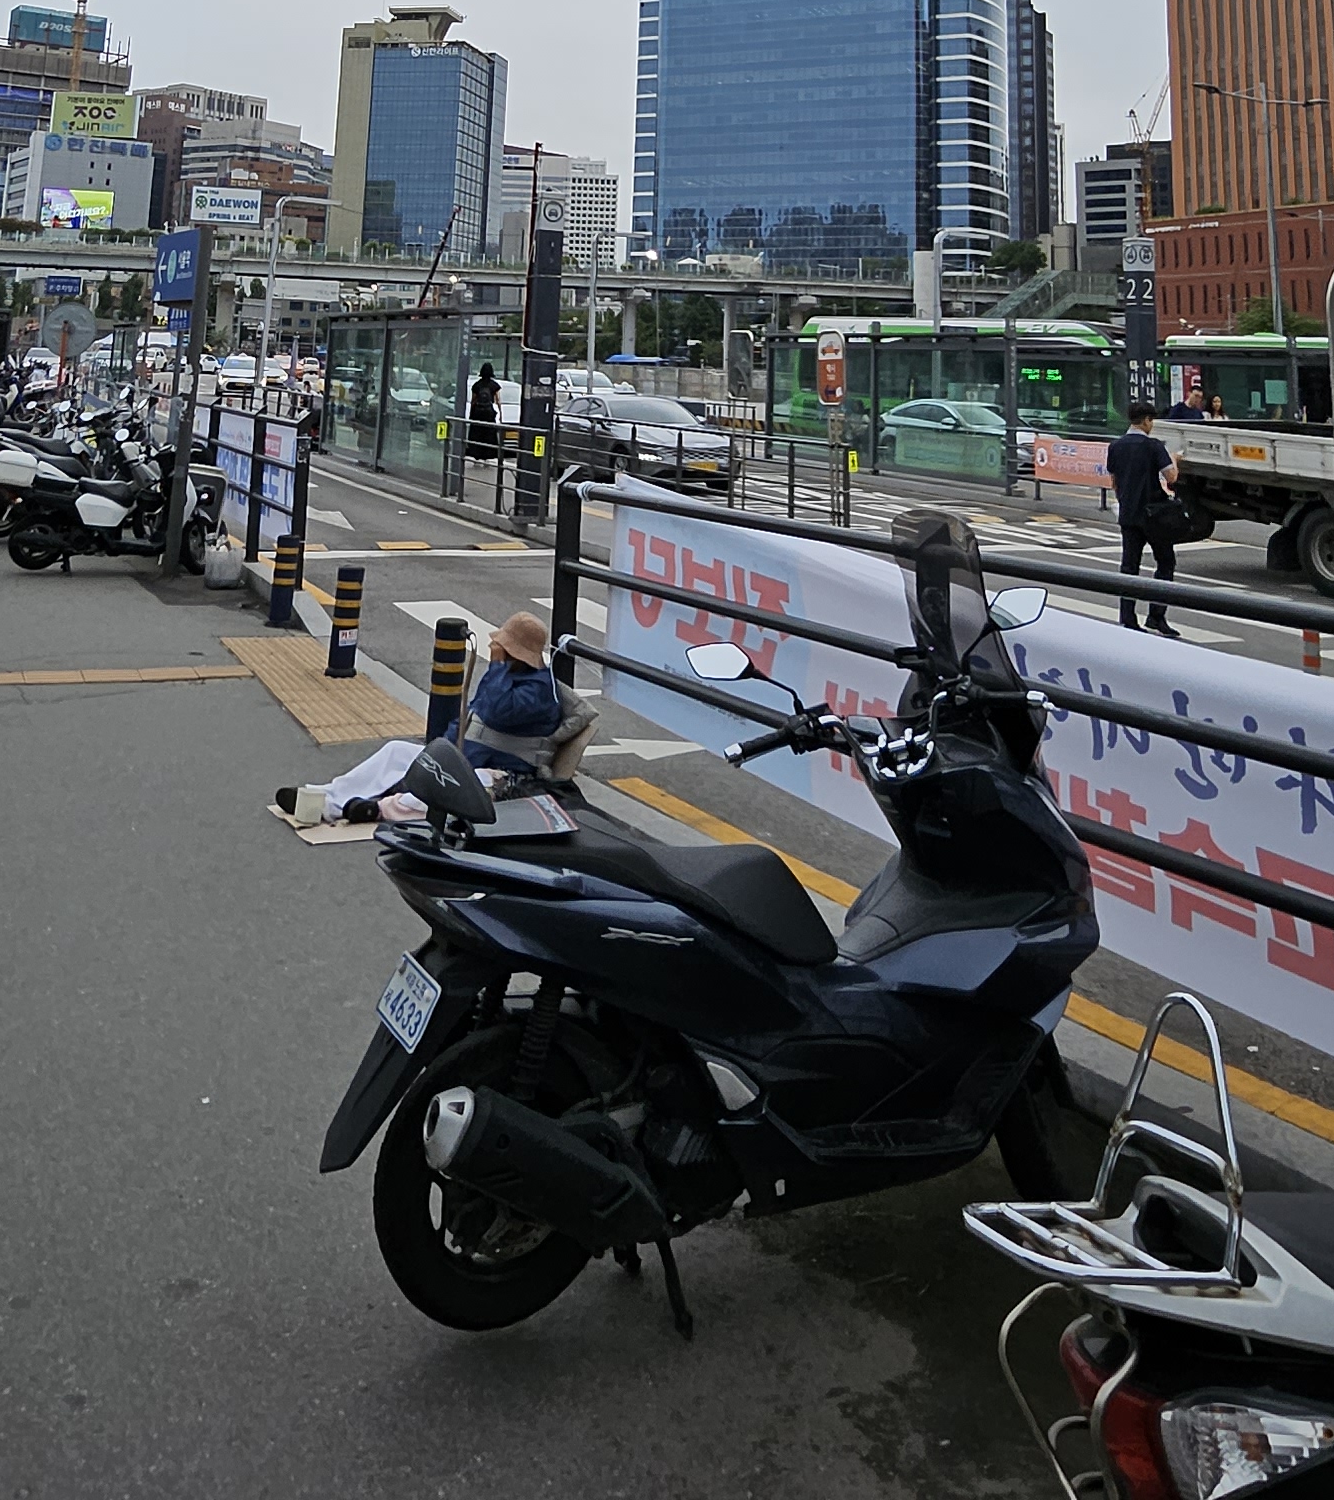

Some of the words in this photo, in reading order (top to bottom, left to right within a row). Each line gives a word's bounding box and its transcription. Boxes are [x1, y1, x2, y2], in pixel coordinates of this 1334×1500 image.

[422, 47, 459, 56] 신한라이프
[209, 197, 259, 210] DAEWON
[208, 212, 231, 220] SPRING
[1142, 278, 1154, 300] 2
[390, 988, 422, 1038] 4633
